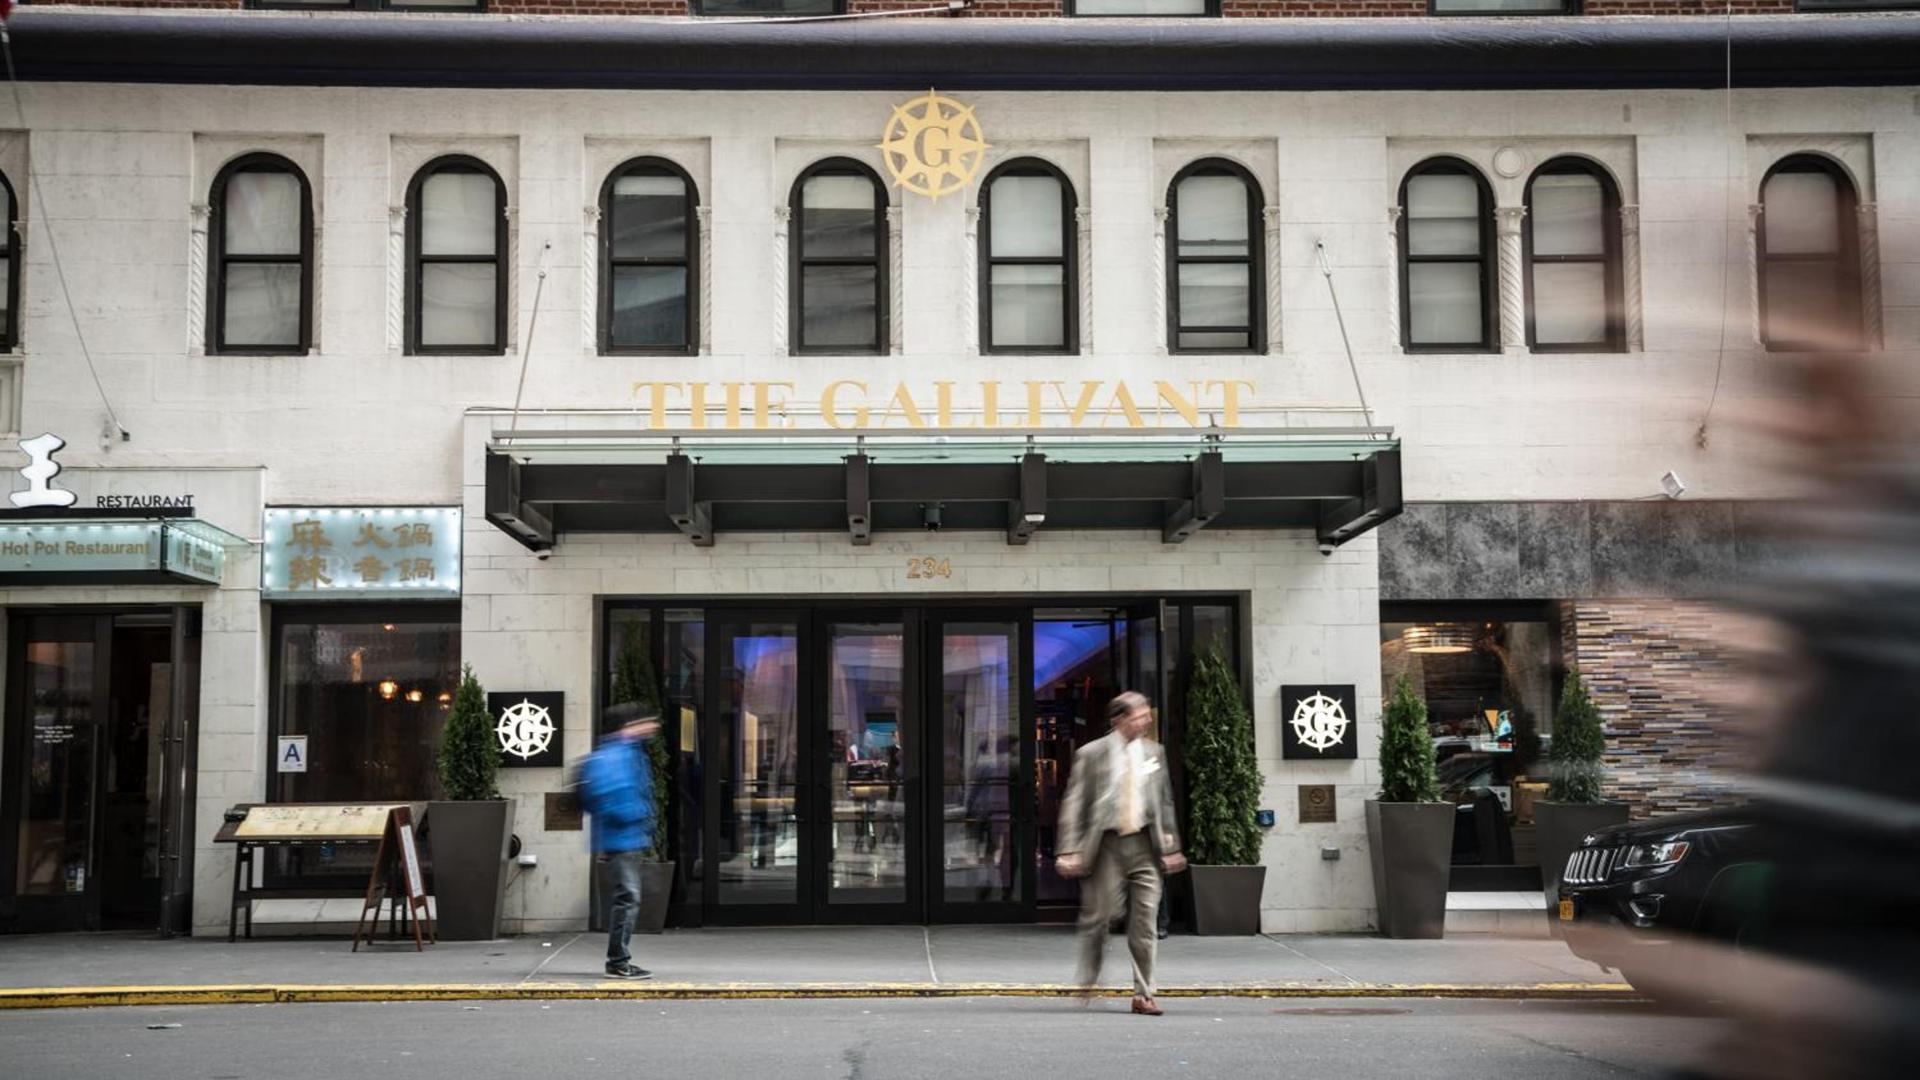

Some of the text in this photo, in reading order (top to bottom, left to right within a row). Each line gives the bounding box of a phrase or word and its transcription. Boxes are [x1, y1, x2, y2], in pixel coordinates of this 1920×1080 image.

[632, 379, 1256, 429] THE GALLIVANT
[96, 494, 194, 508] RESTAURANT
[2, 540, 150, 556] Hot Pot Restaurant
[906, 557, 952, 579] 234
[284, 743, 301, 763] A
